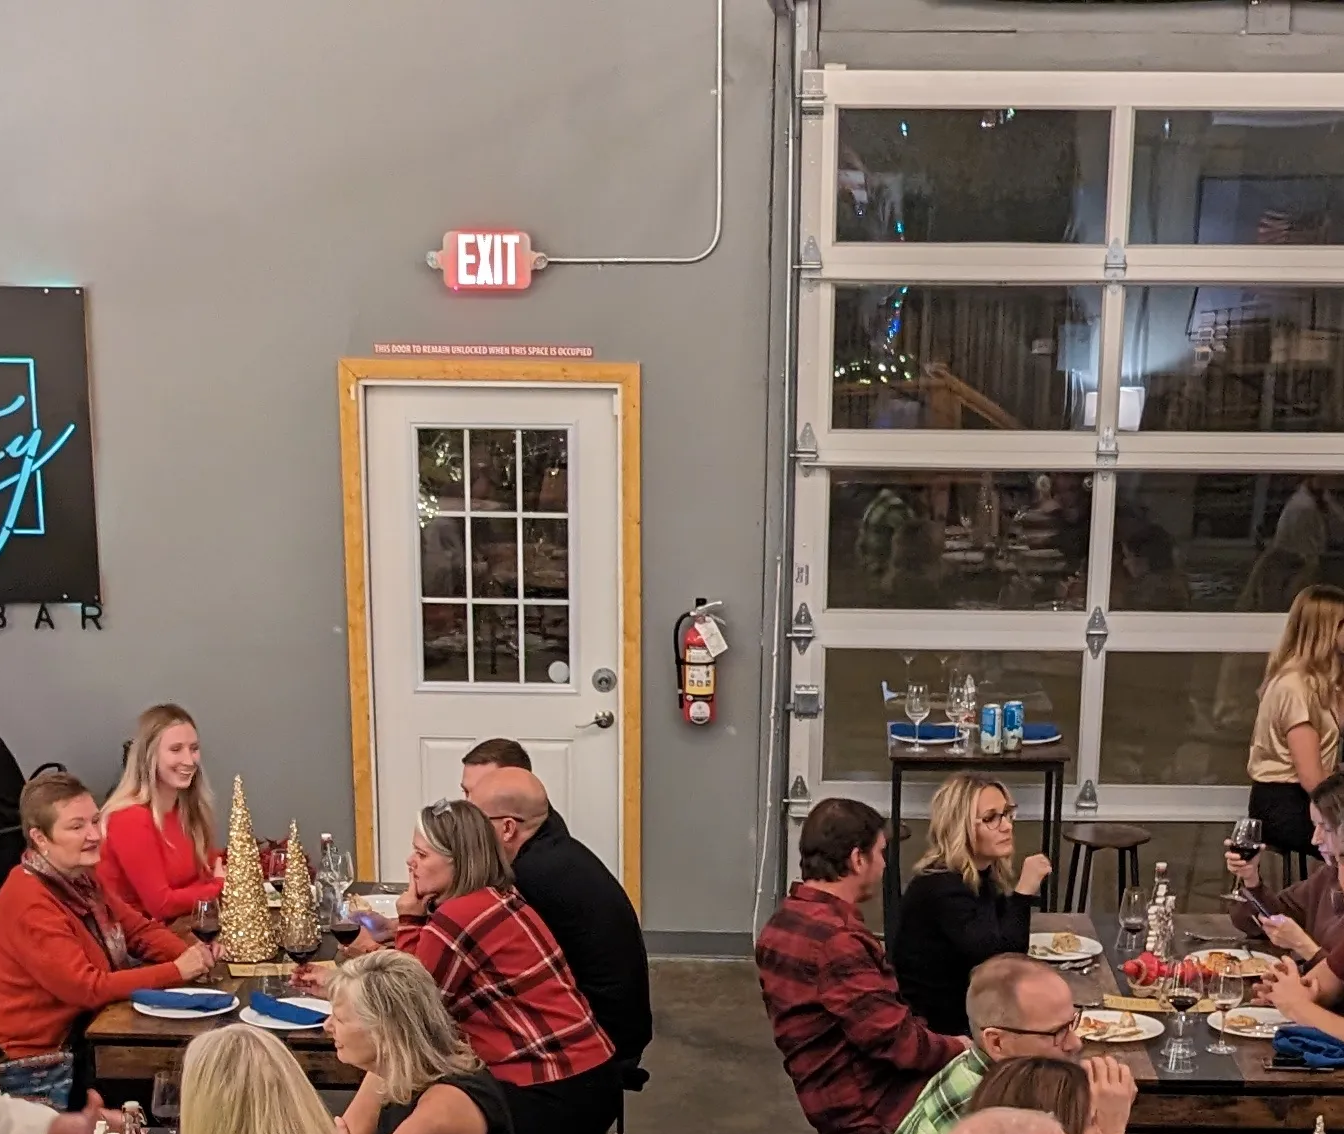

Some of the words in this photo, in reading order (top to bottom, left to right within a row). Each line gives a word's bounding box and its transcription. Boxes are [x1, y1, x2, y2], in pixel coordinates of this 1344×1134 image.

[457, 233, 520, 285] EXIT
[373, 343, 390, 353] THIS
[391, 343, 411, 353] DOOR
[412, 344, 421, 353] TO
[422, 344, 450, 354] REMAIN
[451, 345, 488, 355] UNLOCKED
[488, 346, 510, 355] WHEN
[511, 346, 527, 356] THIS
[527, 346, 549, 356] SPACE
[550, 347, 557, 356] IS
[557, 347, 593, 357] OCCUPIED
